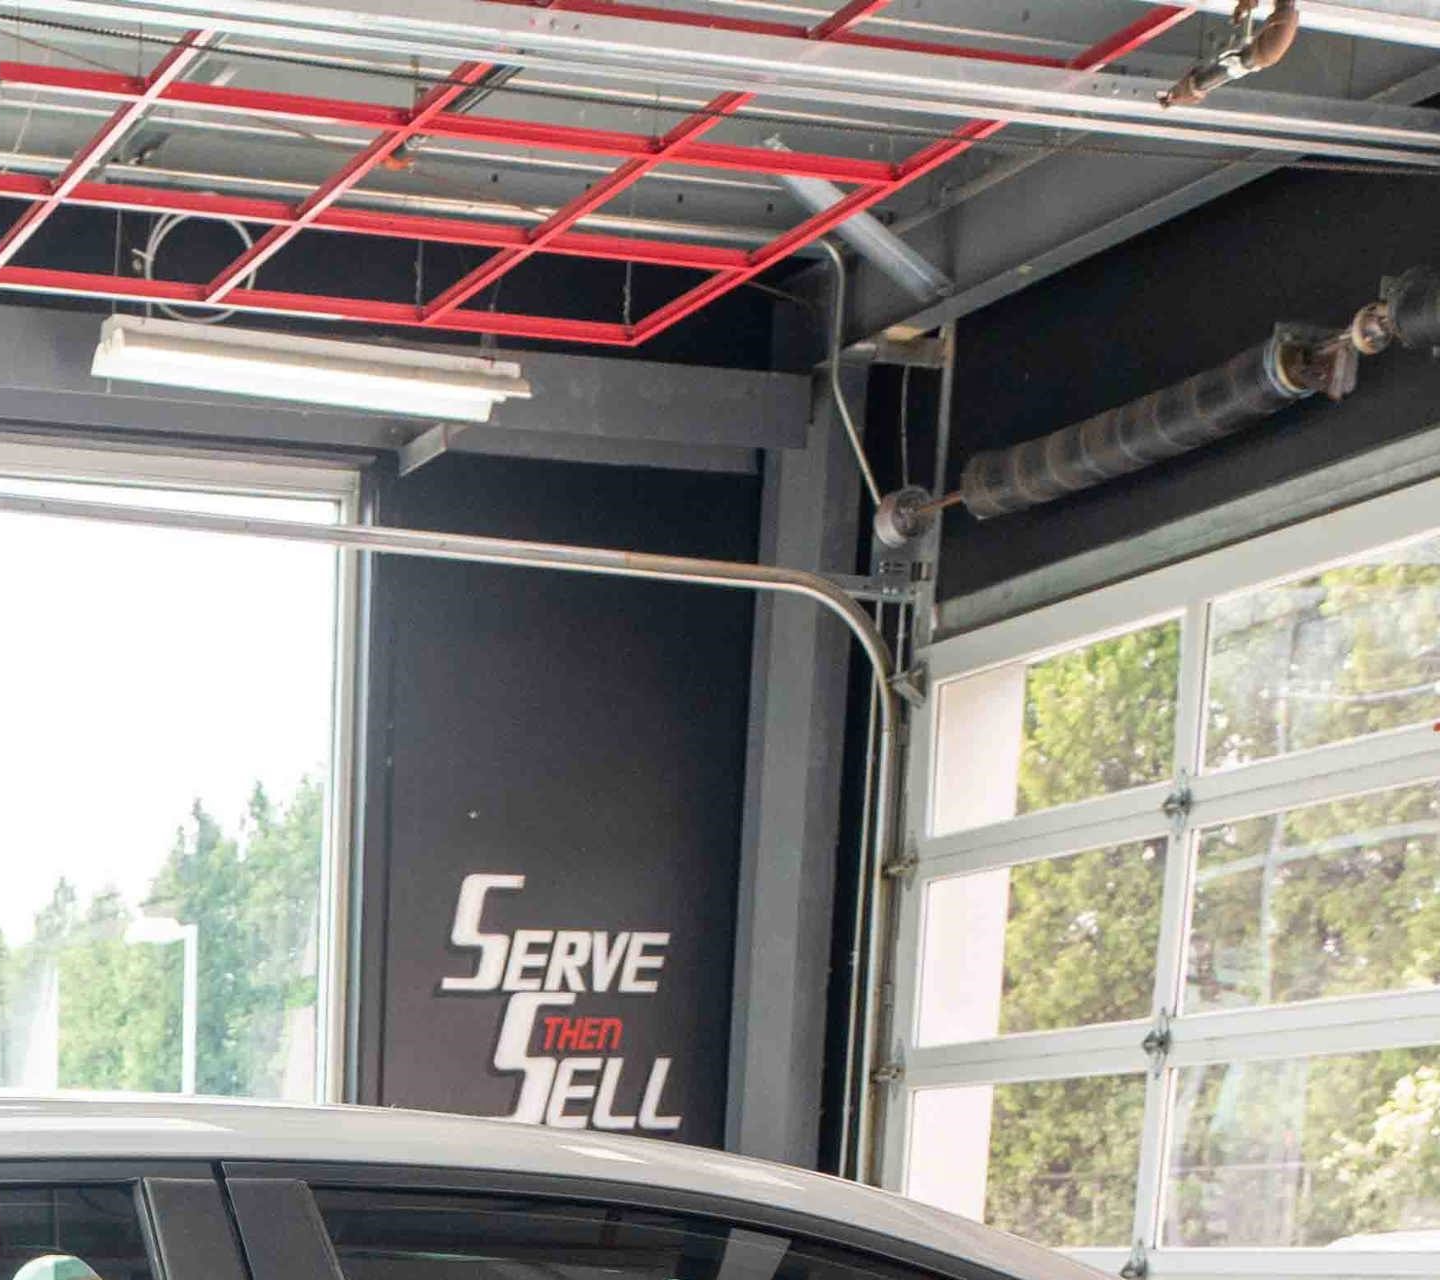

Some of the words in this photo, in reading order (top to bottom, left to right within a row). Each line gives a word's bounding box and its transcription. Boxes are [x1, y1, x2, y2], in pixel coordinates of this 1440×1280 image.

[441, 873, 670, 993] SERVE
[492, 992, 683, 1131] SELL
[543, 1016, 624, 1051] THEN
